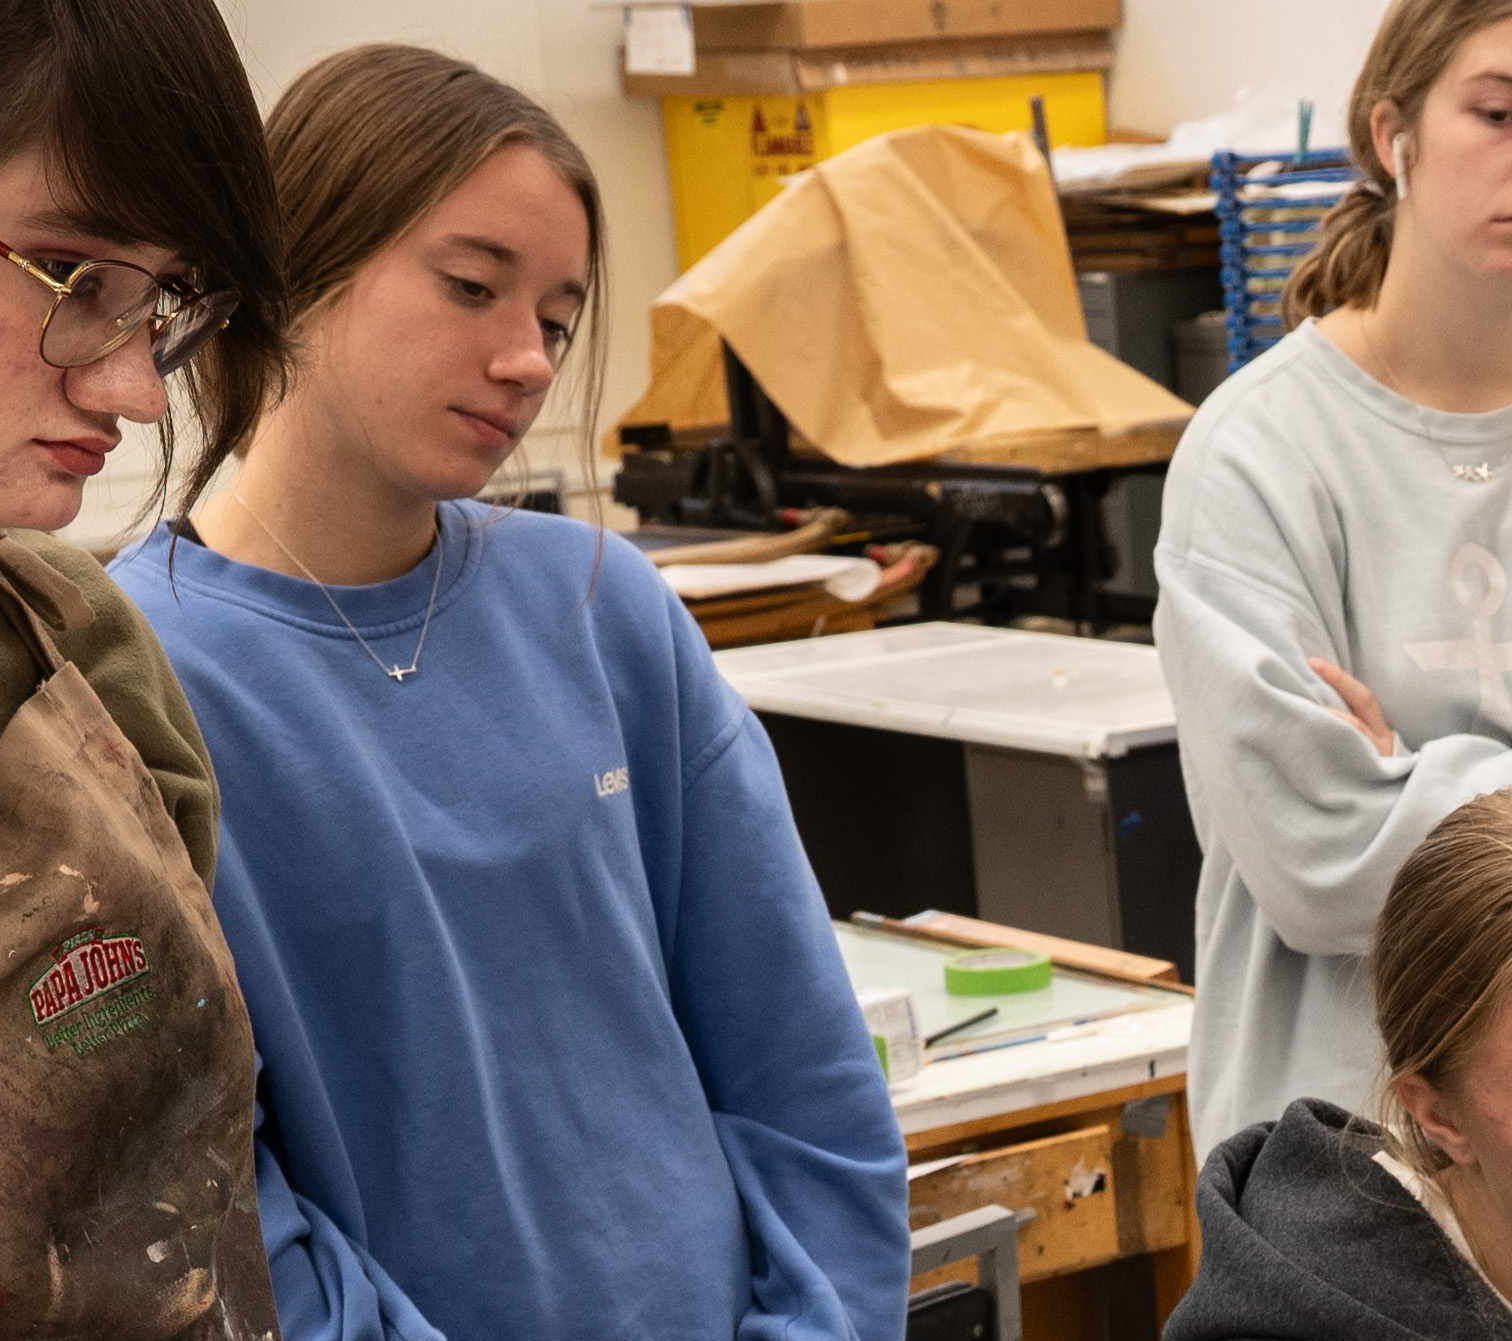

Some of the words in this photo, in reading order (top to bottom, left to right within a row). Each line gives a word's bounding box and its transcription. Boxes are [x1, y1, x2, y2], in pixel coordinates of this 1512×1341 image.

[31, 961, 84, 1022] PAPA
[44, 1021, 82, 1049] Better
[70, 1030, 108, 1054] Better
